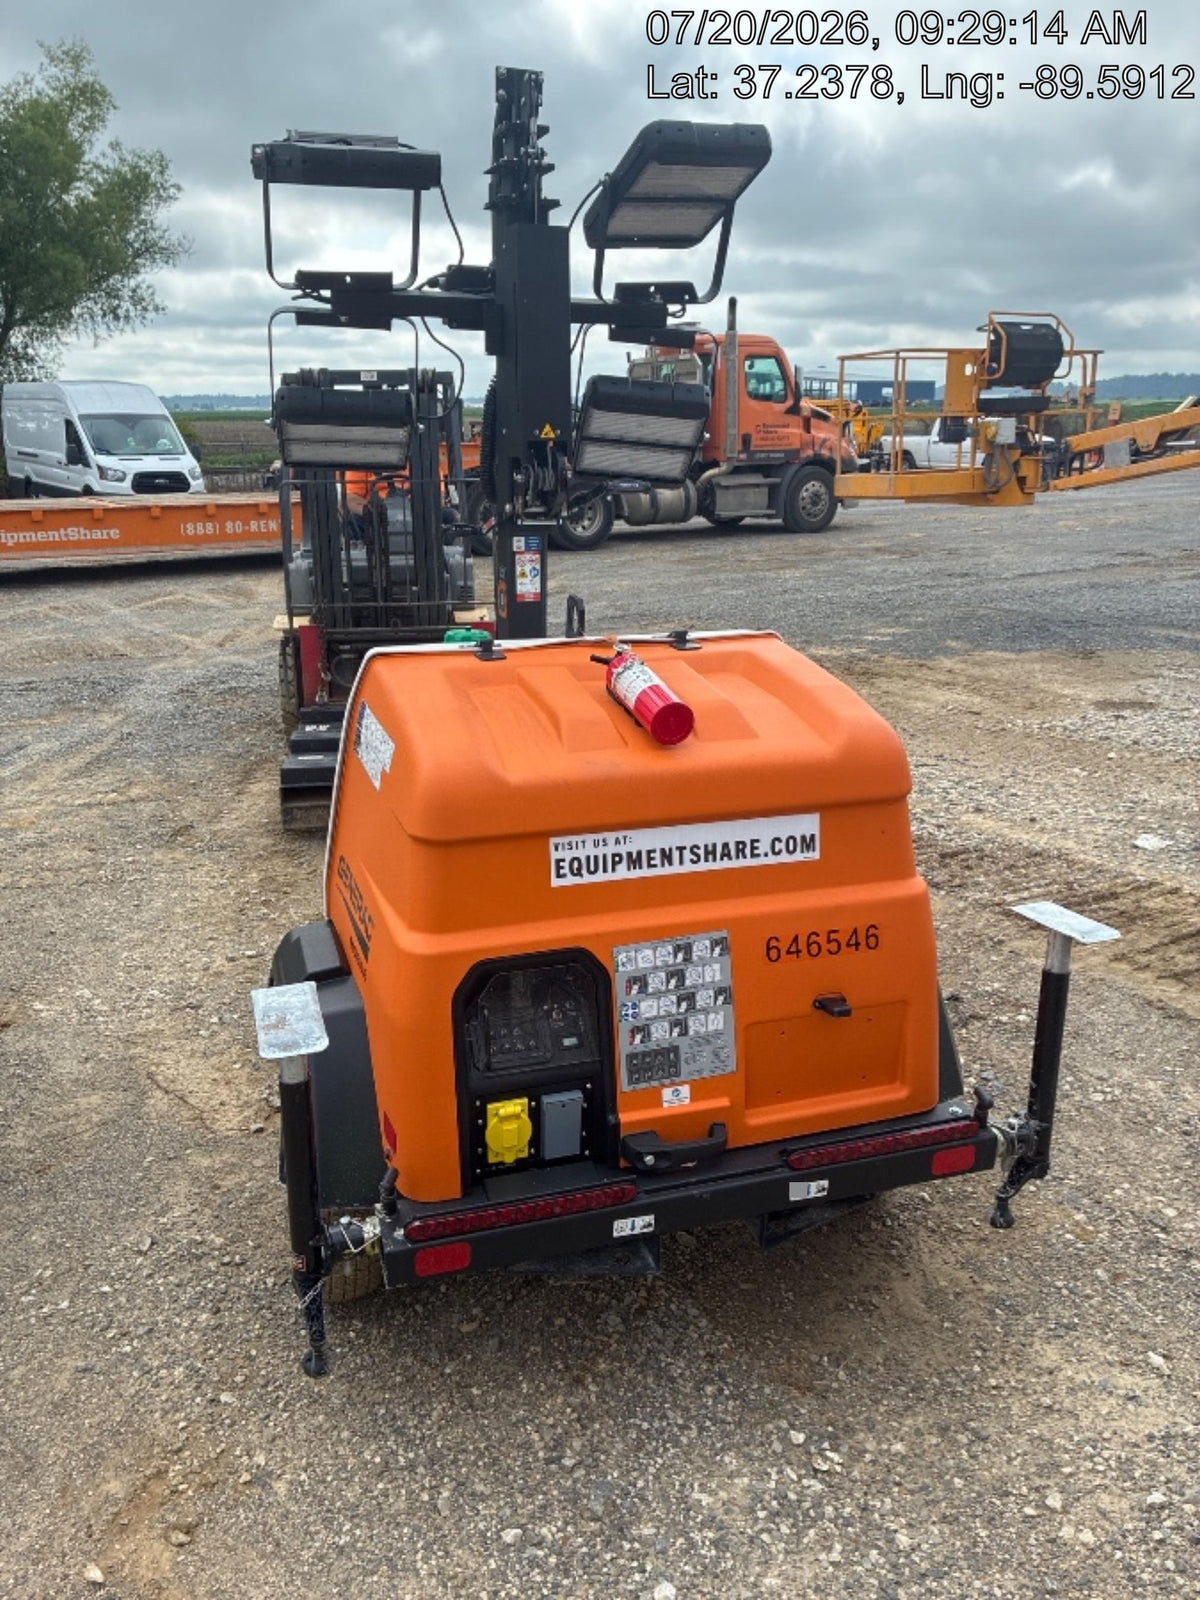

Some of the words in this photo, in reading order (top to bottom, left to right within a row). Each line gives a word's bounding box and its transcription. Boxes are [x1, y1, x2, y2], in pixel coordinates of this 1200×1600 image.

[0, 526, 120, 546] ipmentShare
[180, 521, 219, 536] (888)
[225, 518, 294, 534] 80-REN
[553, 840, 586, 852] VISIT
[593, 837, 608, 848] US
[615, 834, 633, 847] AT:
[555, 833, 816, 879] EQUIPMENTSHARE.COM
[765, 924, 880, 963] 646546
